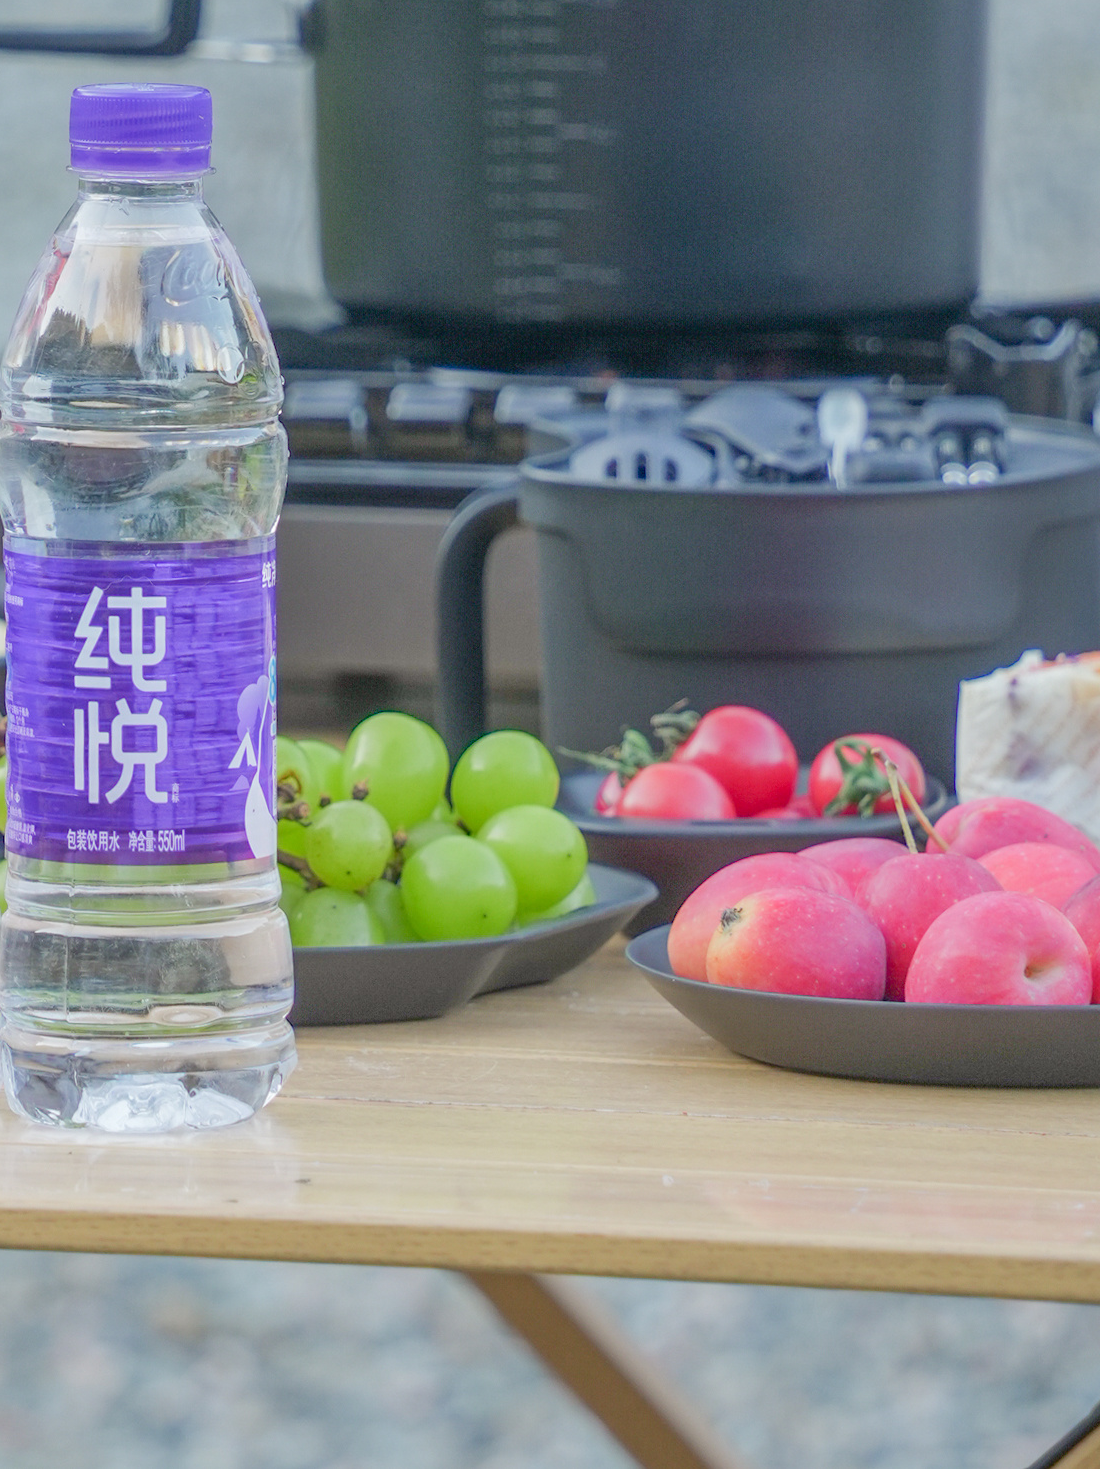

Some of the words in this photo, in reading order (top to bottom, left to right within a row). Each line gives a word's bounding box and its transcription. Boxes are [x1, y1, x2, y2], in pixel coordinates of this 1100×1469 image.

[74, 586, 168, 804] 纯悦
[67, 829, 120, 851] 包装饮用水
